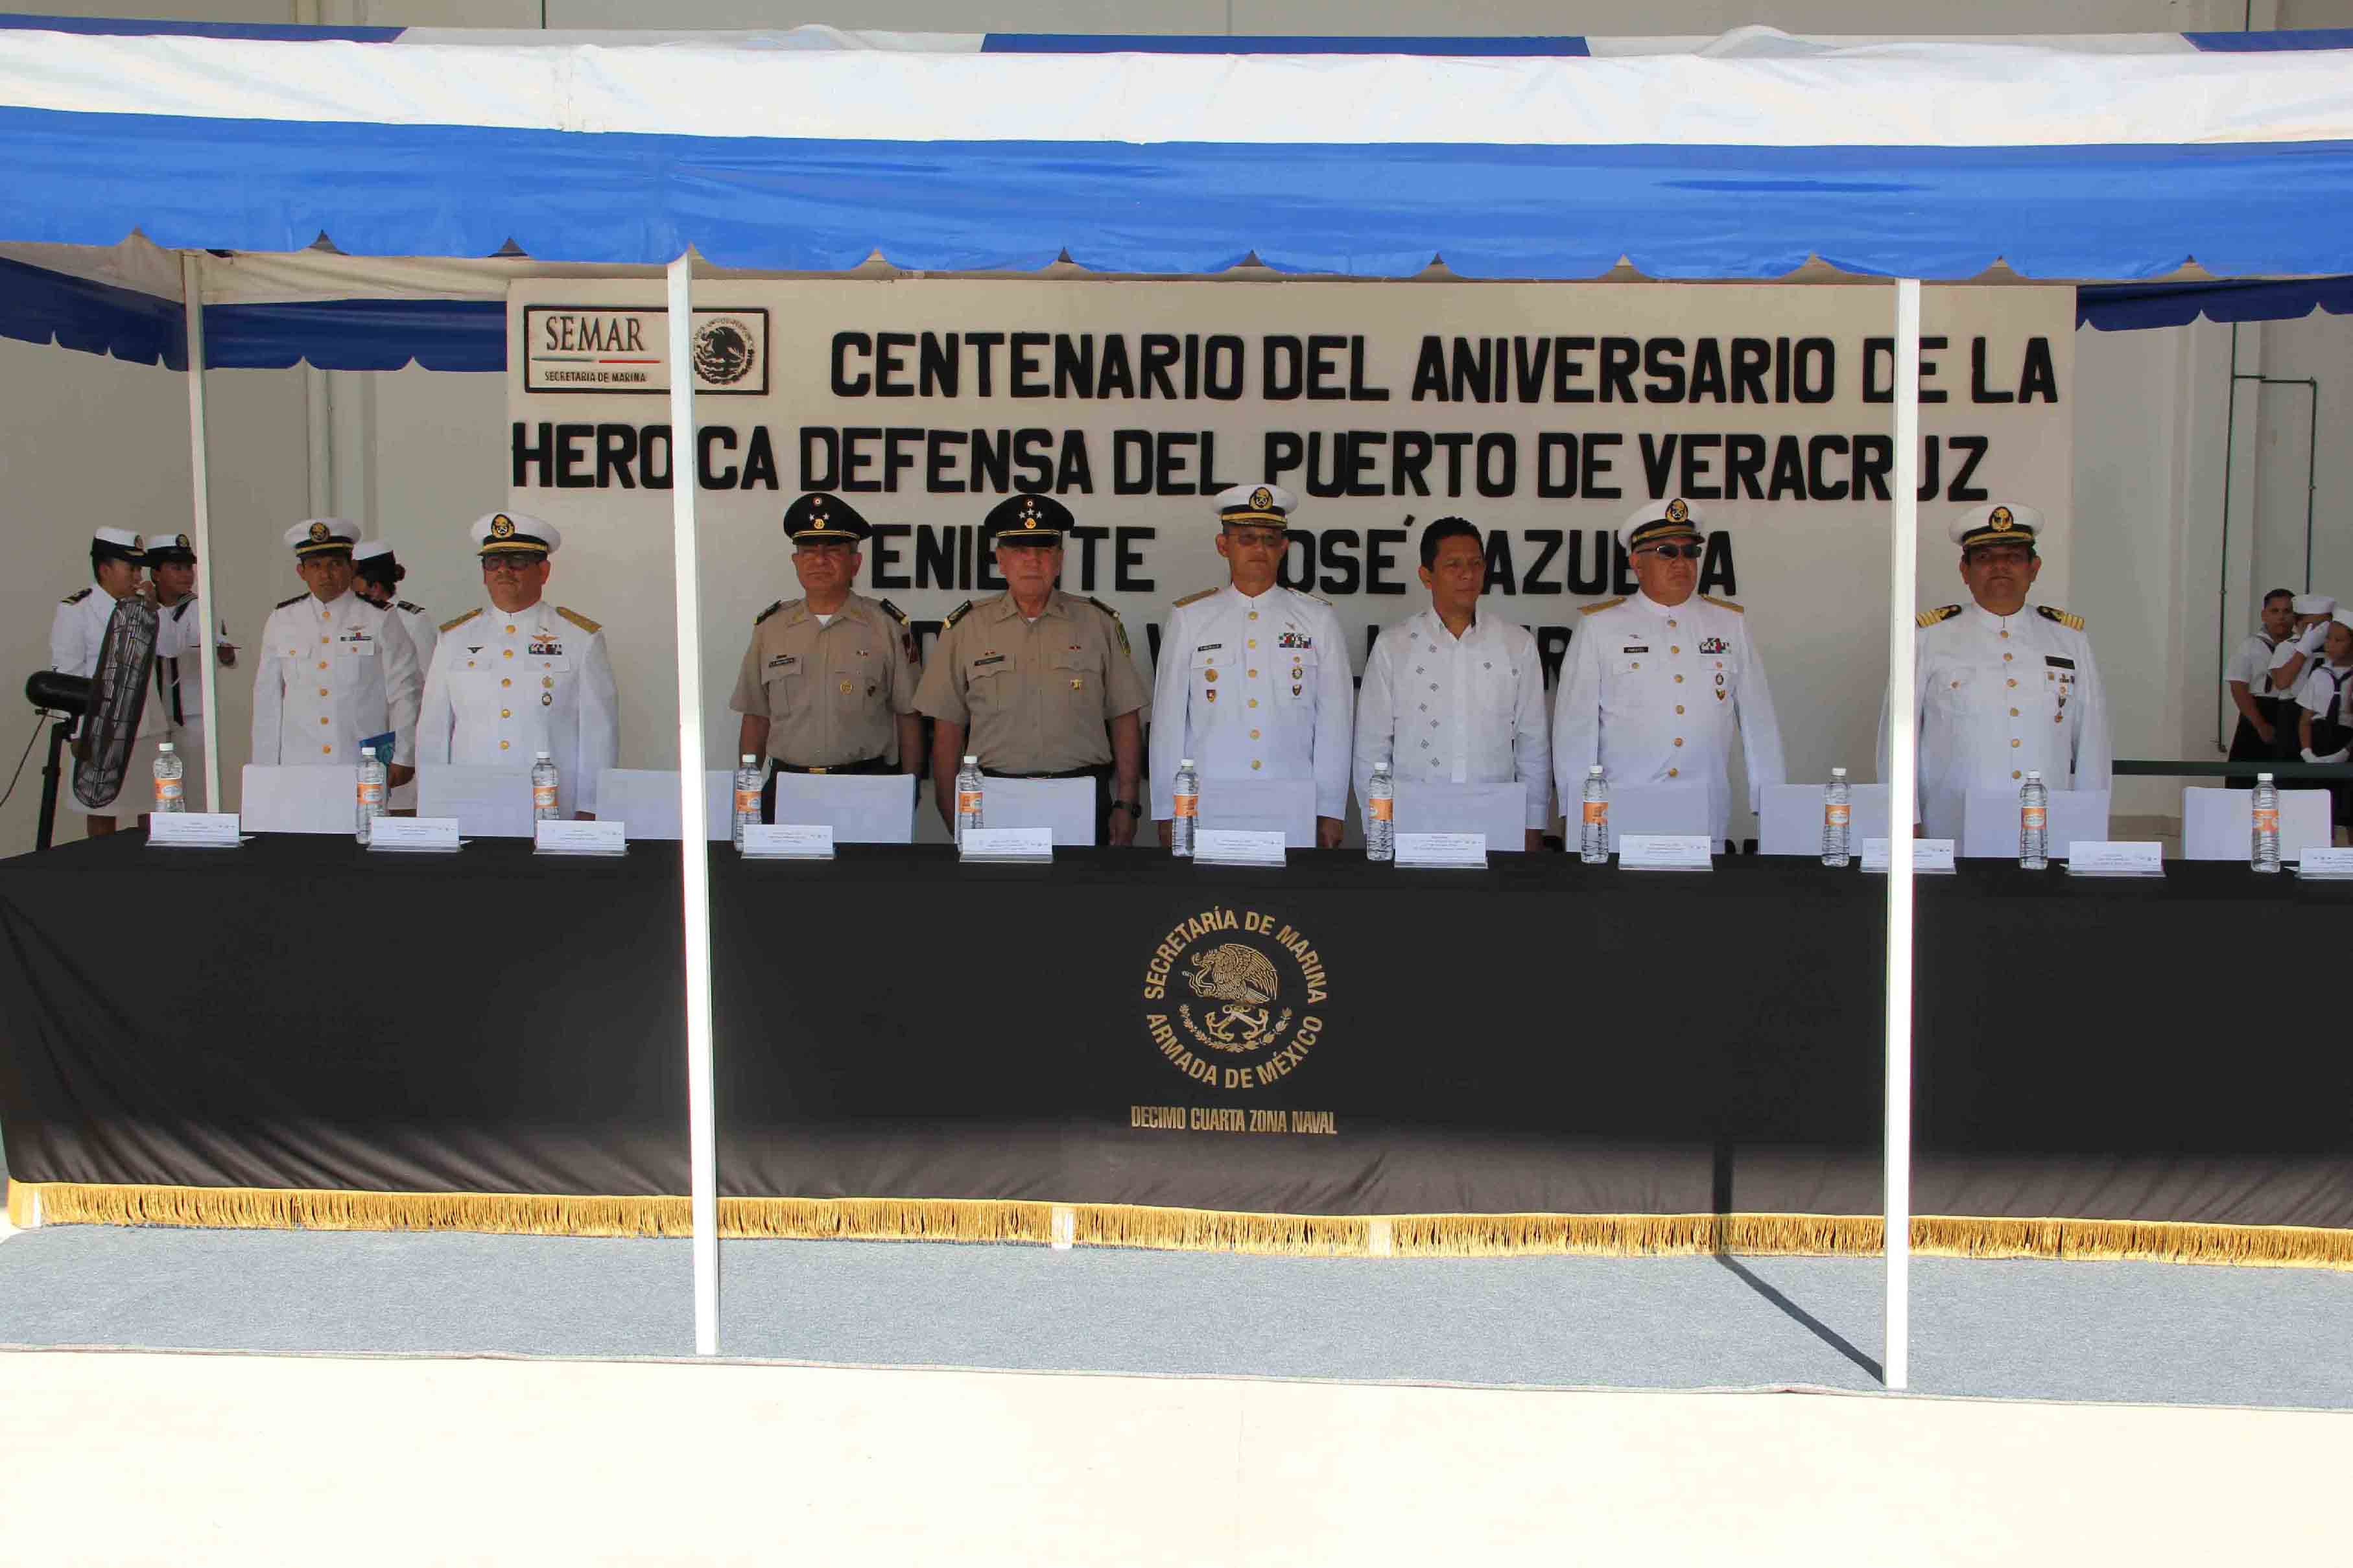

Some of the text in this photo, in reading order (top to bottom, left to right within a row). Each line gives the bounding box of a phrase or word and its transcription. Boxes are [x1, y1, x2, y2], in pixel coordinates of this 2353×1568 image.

[546, 316, 644, 351] SEMAR
[832, 332, 1244, 401] CENTENARIO
[1263, 335, 1389, 401] DEL
[1412, 336, 1834, 403] ANIVERSARIO
[1863, 336, 1948, 403] DE
[1972, 336, 2058, 403] LA
[598, 372, 608, 382] DE
[611, 372, 646, 382] MARINA
[512, 423, 779, 491] HEROCA
[799, 427, 1093, 495] DEFENSA
[1113, 429, 1238, 496] DEL
[1265, 430, 1516, 498] PUERTO
[1538, 432, 1622, 498] DE
[871, 524, 1155, 592] ENIETE
[1277, 514, 1415, 594] OSÉ
[1144, 906, 1328, 1004] SECRETARÍA DE MARINA
[1146, 1013, 1323, 1089] ARMADA DE MÉXICO
[1131, 1105, 1338, 1135] DECIMO CUARTA ZONA NAVAL
